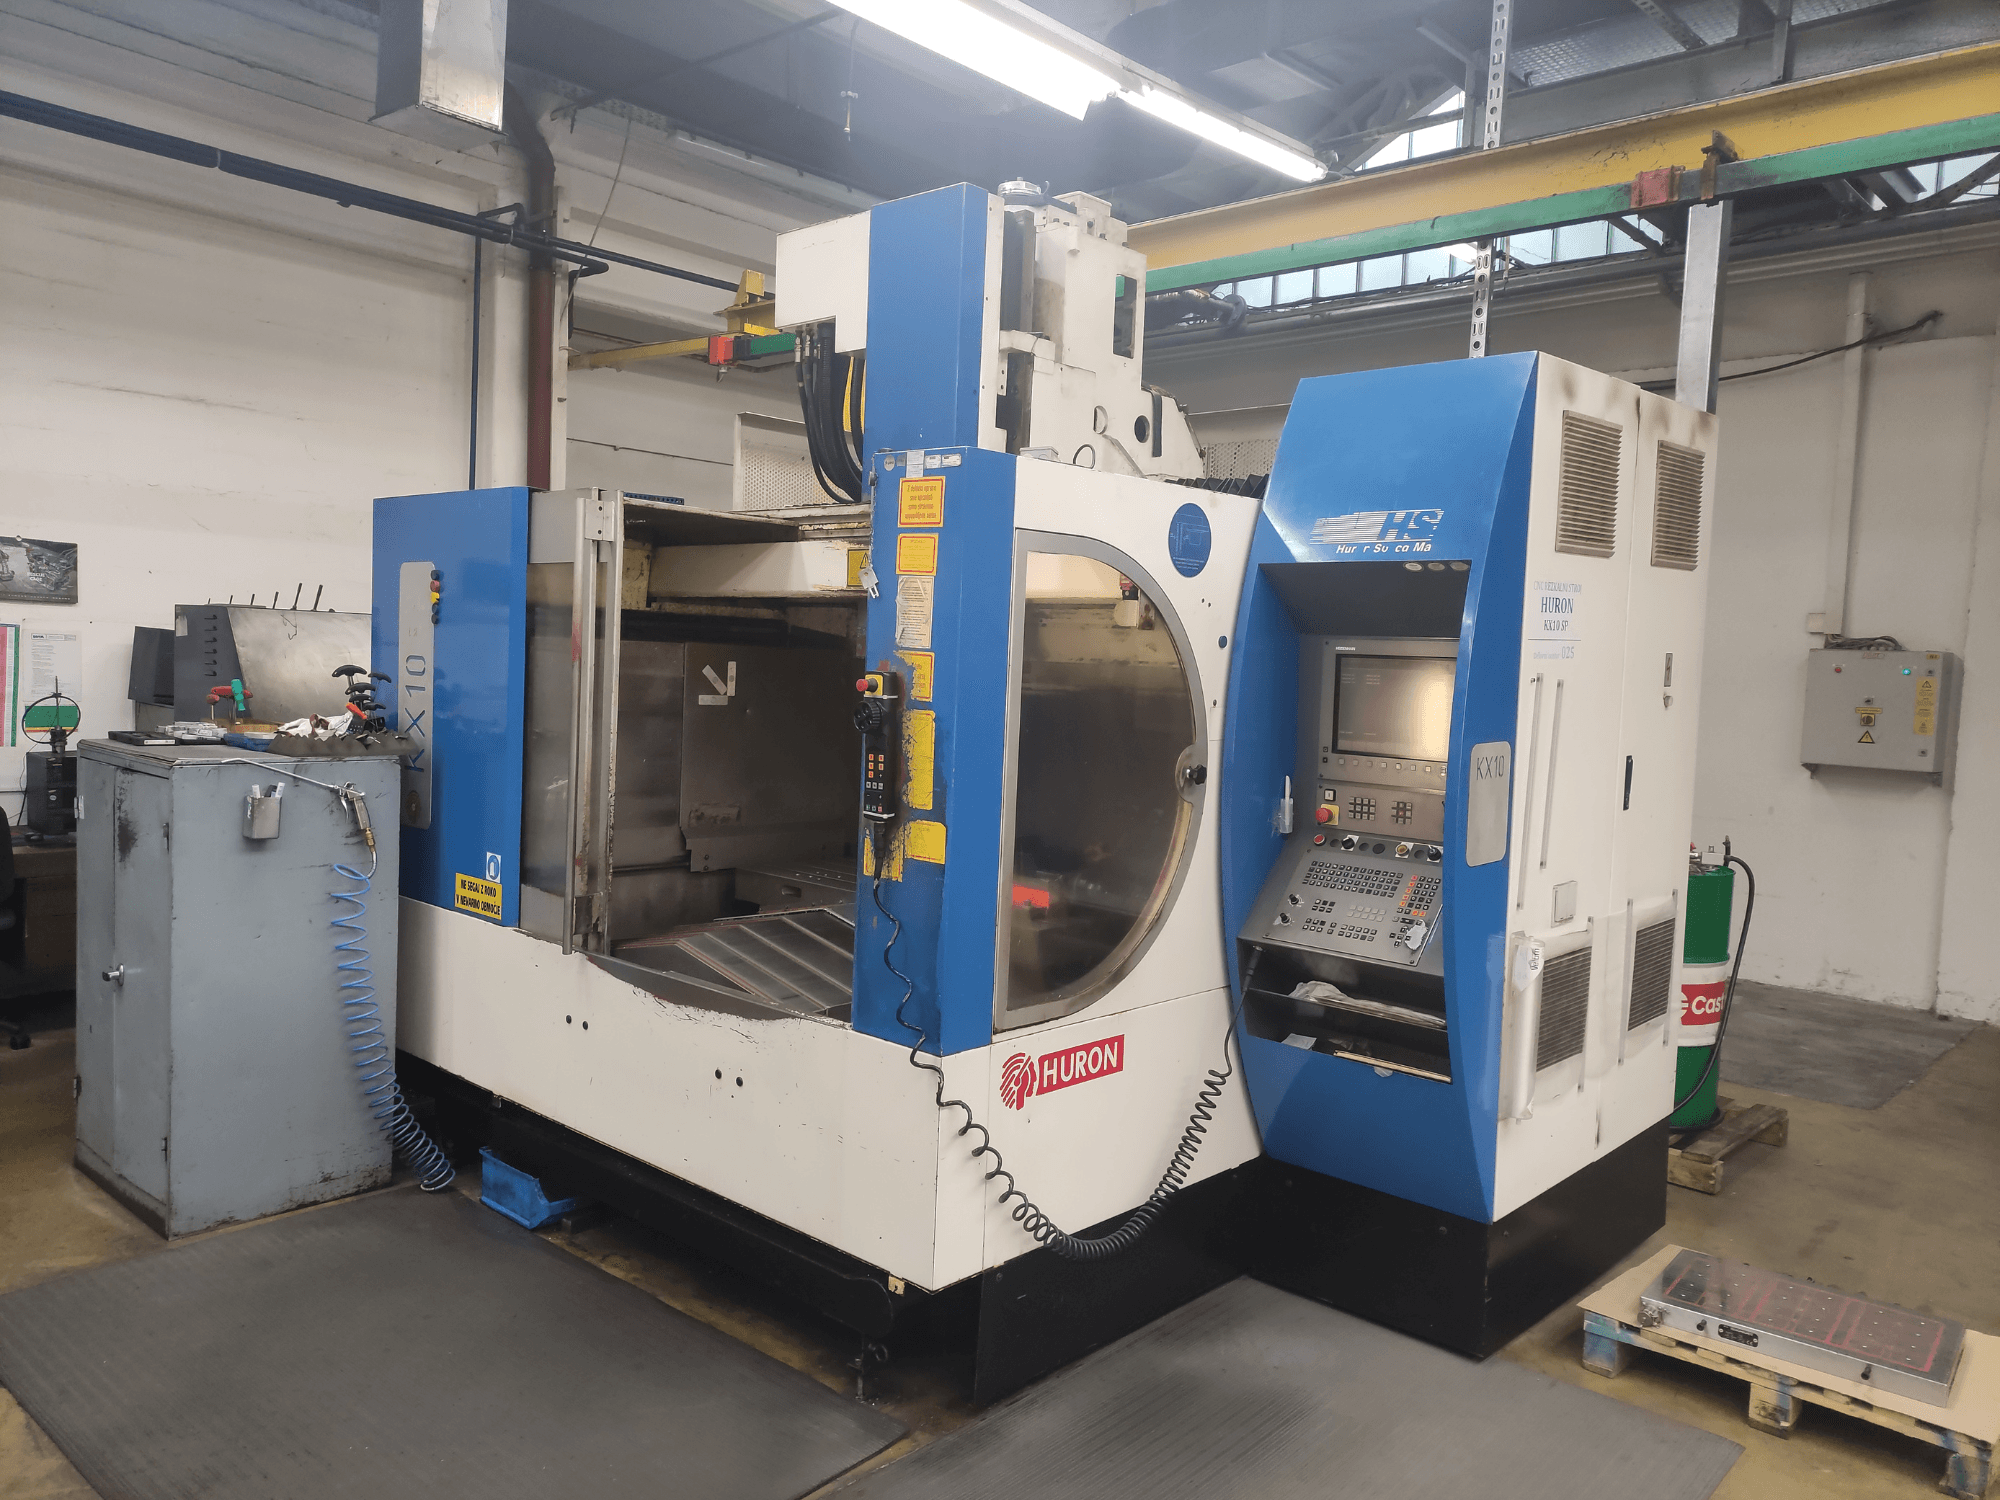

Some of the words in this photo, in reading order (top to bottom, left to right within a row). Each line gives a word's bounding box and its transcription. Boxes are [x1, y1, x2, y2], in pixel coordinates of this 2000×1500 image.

[1541, 596, 1574, 613] HURON
[1544, 619, 1560, 631] KX10
[1476, 755, 1505, 780] KX10
[1042, 1041, 1118, 1088] HURON
